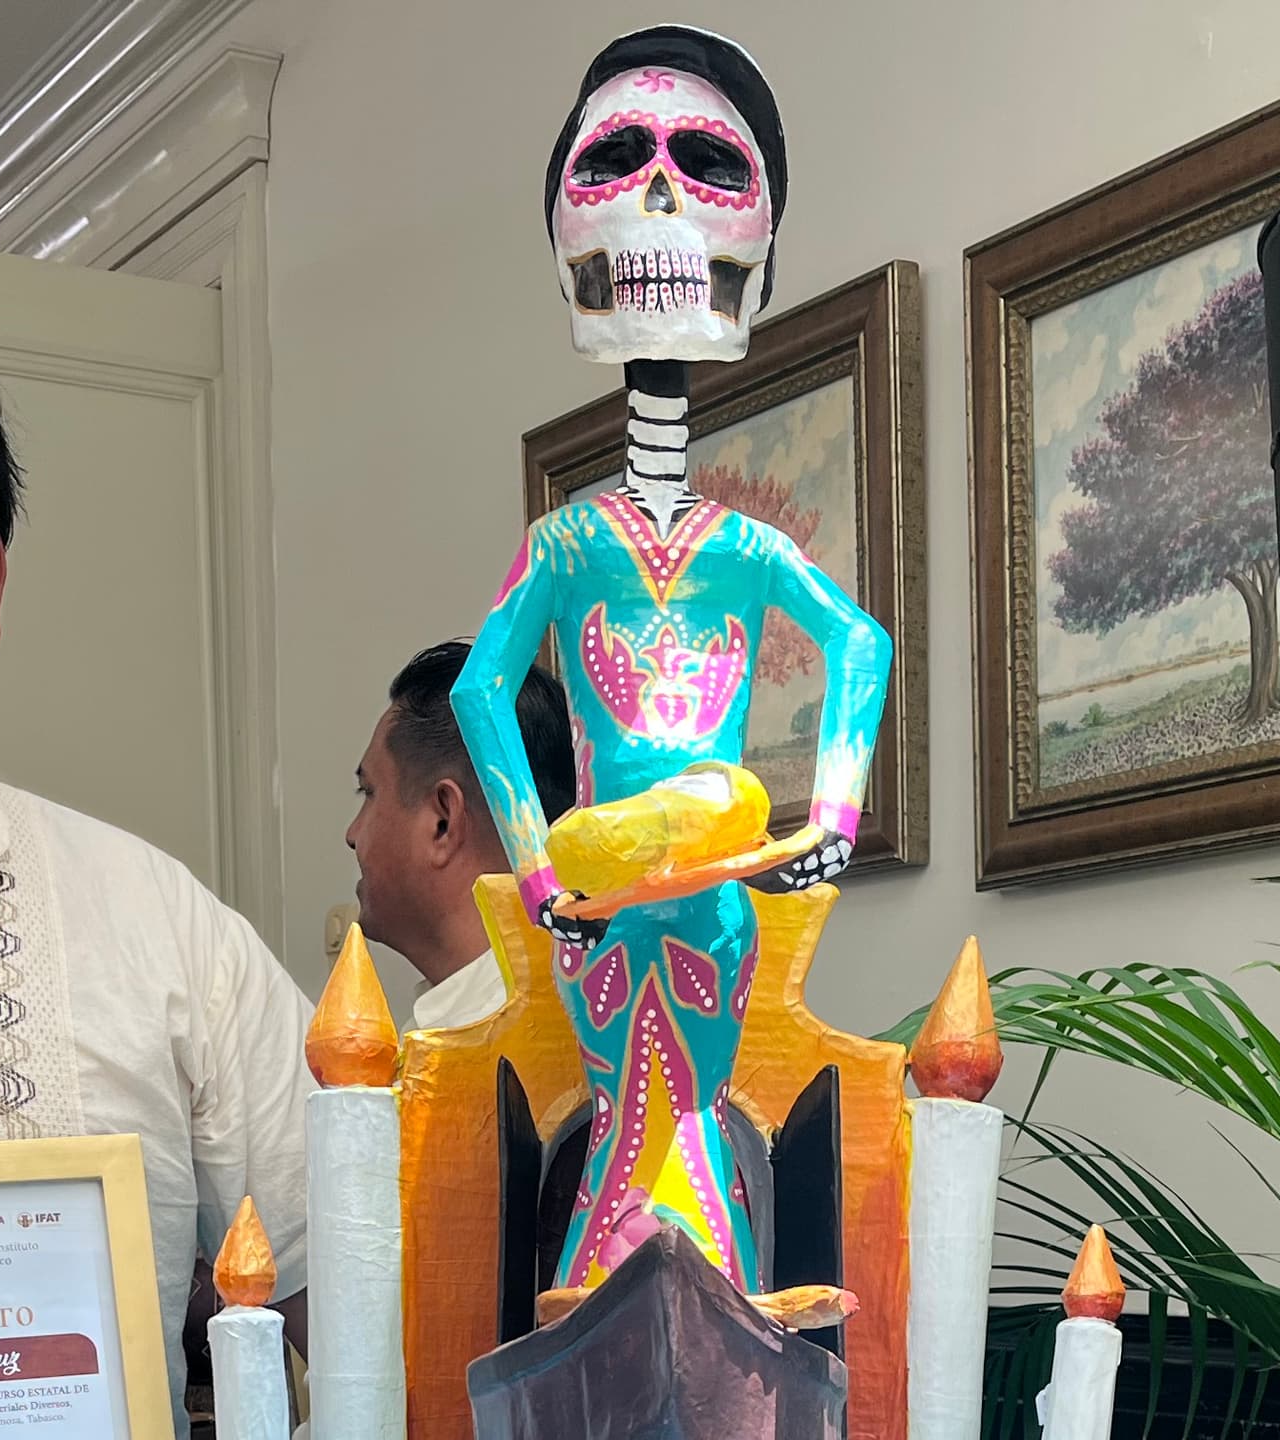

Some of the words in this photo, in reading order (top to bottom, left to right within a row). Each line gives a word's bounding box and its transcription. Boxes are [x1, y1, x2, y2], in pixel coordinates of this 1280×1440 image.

[35, 1213, 61, 1223] IFAT
[28, 1385, 71, 1397] ESTATAL
[74, 1384, 89, 1394] DE
